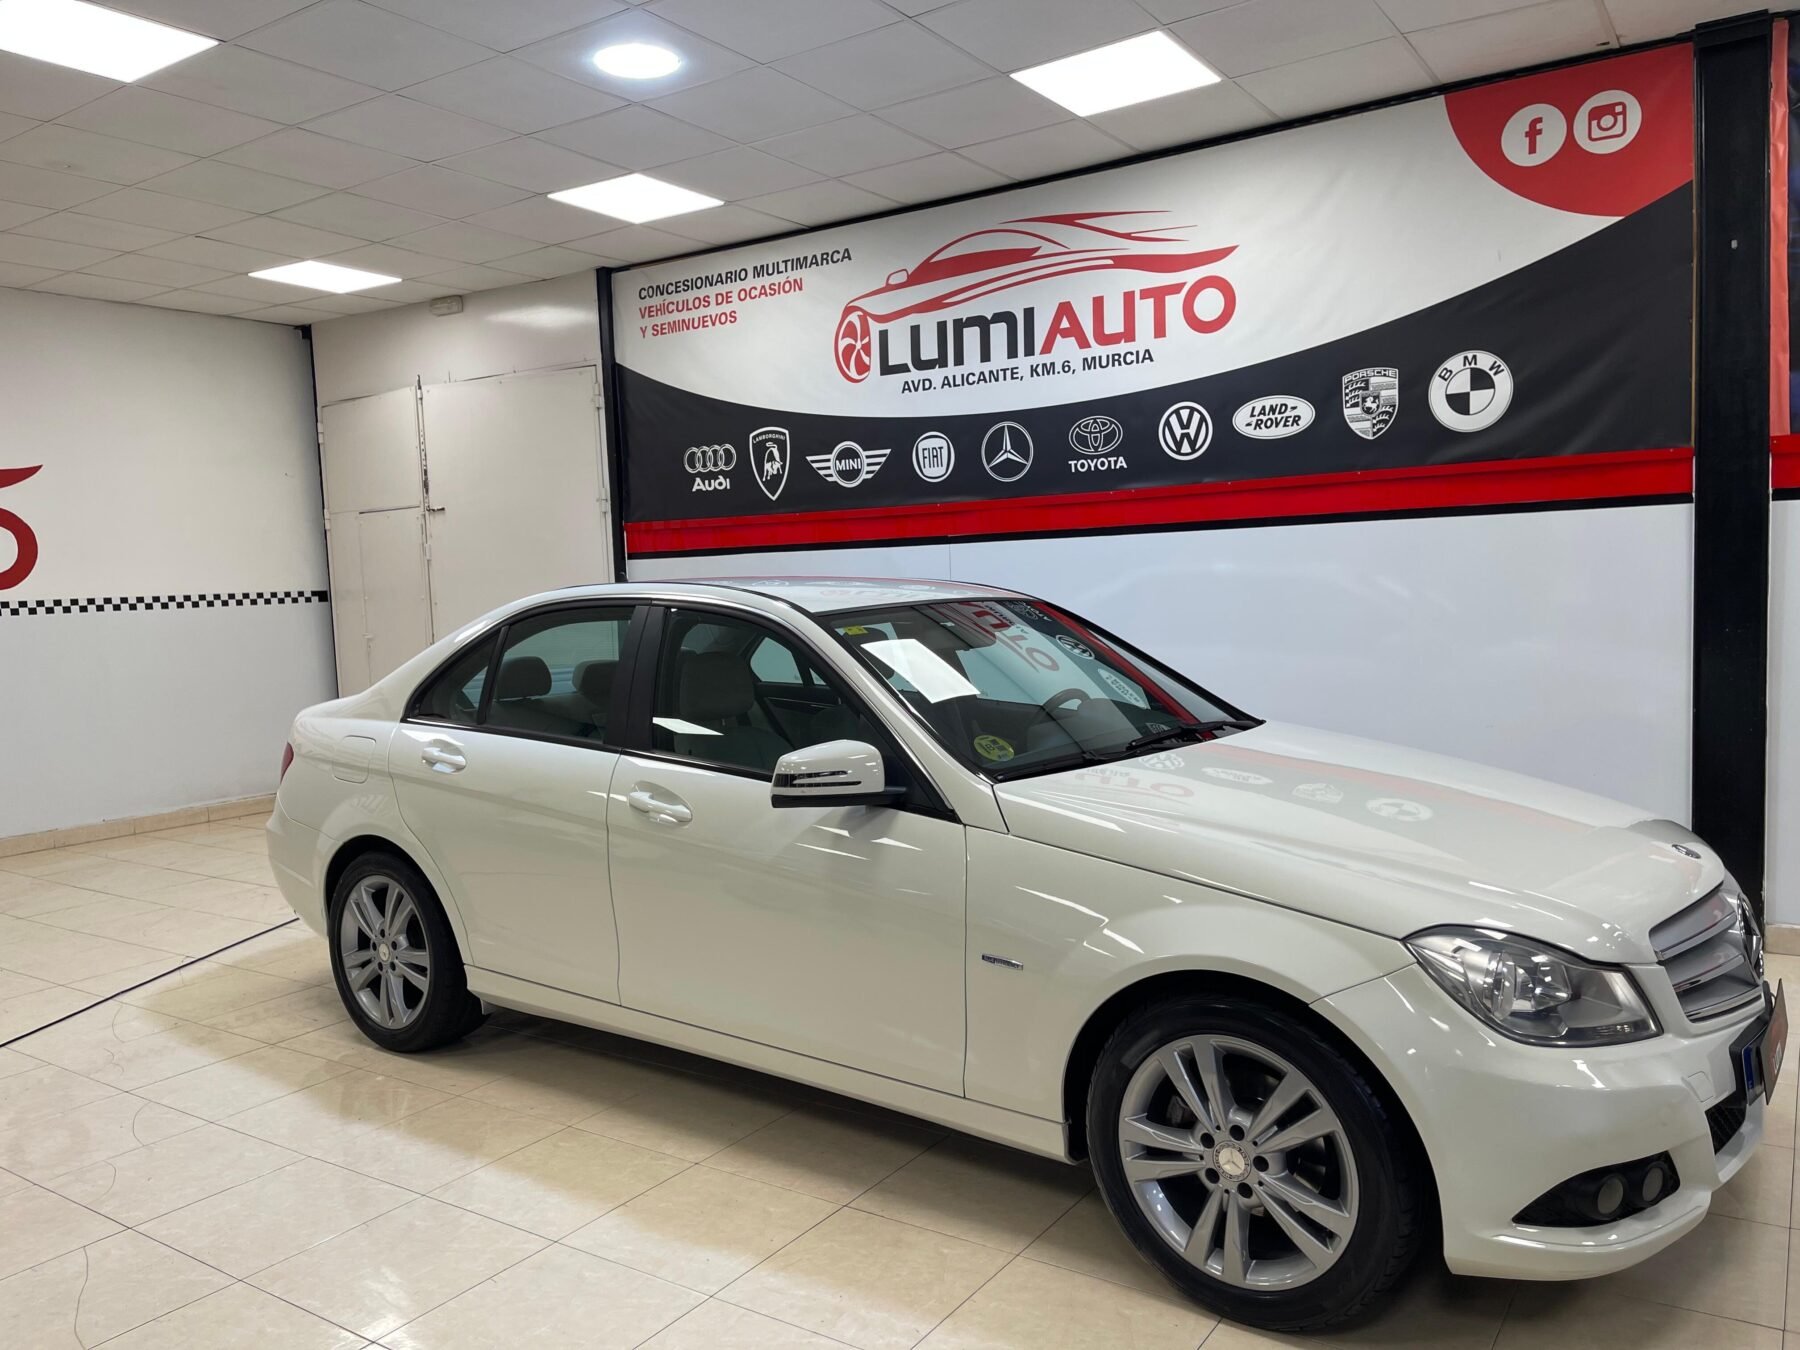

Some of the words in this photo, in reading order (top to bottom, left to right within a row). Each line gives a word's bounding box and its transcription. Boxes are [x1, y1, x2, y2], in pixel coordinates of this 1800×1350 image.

[638, 268, 748, 300] CONCESIONARIO
[752, 247, 852, 279] MULTIMARCA
[639, 294, 711, 319] VEHÍCULOS
[715, 290, 733, 306] DE
[737, 276, 803, 302] OCASIÓN
[639, 325, 648, 339] Y
[651, 310, 737, 337] SEMINUEVOS
[901, 378, 936, 394] AVD.
[940, 367, 1024, 389] ALICANTE,
[1029, 360, 1076, 379] KM.6,
[1082, 348, 1154, 372] MURCIA
[1344, 369, 1396, 384] PORSCHE
[1438, 354, 1505, 382] BMW
[1249, 402, 1289, 418] LAND
[1253, 414, 1302, 431] ROVER
[752, 433, 786, 444] LAMBORGHINI
[835, 458, 862, 472] MINI
[921, 444, 945, 470] FIAT
[1068, 455, 1128, 473] TOYOTA
[692, 475, 731, 492] Audi
